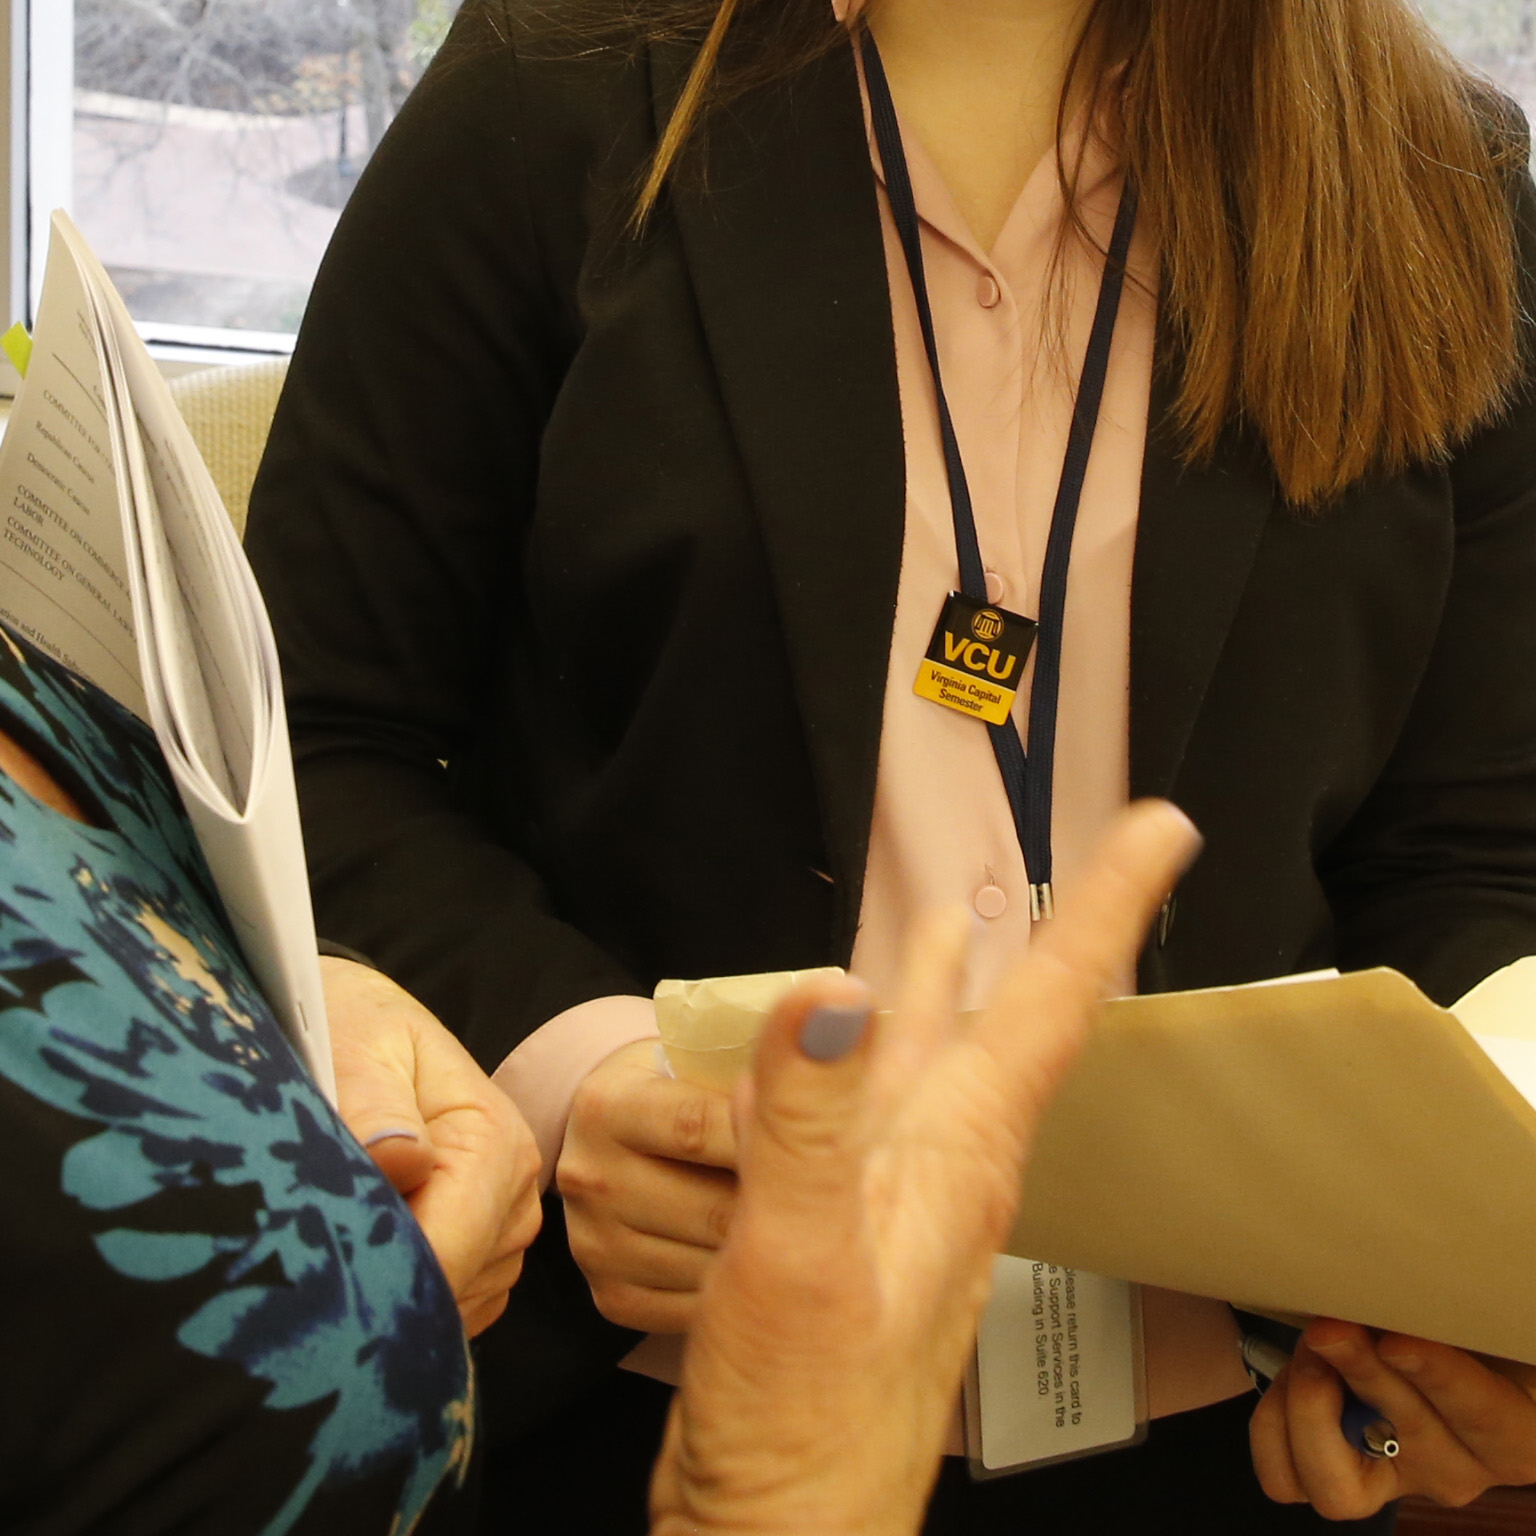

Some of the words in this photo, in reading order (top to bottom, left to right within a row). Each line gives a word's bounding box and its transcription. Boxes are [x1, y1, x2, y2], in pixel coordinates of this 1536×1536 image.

[36, 420, 73, 460] Republican
[13, 497, 44, 527] LABOR
[18, 485, 69, 533] COMMITTEE
[69, 529, 83, 546] ON
[3, 528, 65, 582] TECHNOLOGY
[7, 516, 61, 562] COMMITTEE
[61, 559, 75, 576] ON
[75, 571, 112, 611] GENERAL
[20, 623, 36, 638] and
[944, 630, 1016, 680] VCU
[931, 669, 967, 693] Virginia
[968, 684, 1002, 704] Capital
[938, 688, 983, 712] Semester
[1031, 1262, 1044, 1315] Building
[1049, 1278, 1062, 1327] Support
[1035, 1318, 1045, 1332] in
[1067, 1313, 1079, 1352] return
[1036, 1334, 1048, 1368] Suite
[1052, 1329, 1064, 1389] Services
[1069, 1354, 1080, 1377] this
[1055, 1391, 1065, 1405] in
[1070, 1381, 1082, 1410] card
[1056, 1406, 1066, 1429] the
[1071, 1412, 1082, 1426] to
